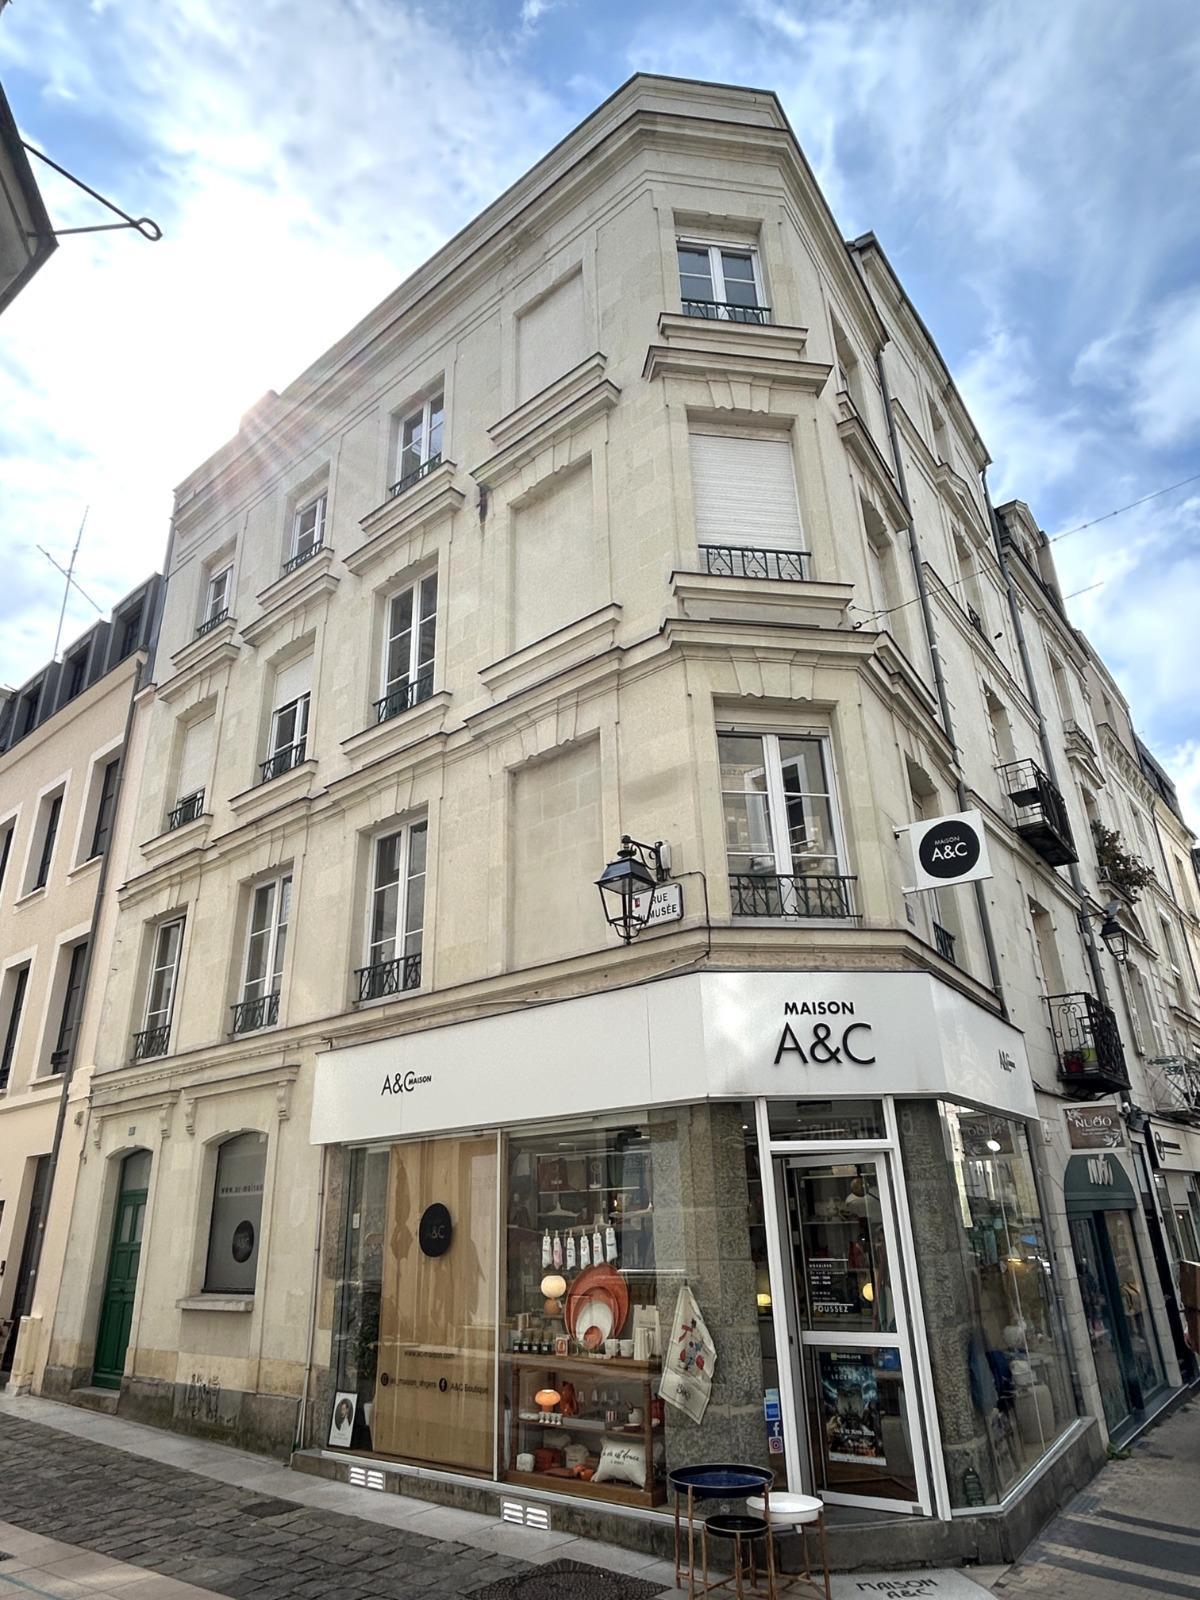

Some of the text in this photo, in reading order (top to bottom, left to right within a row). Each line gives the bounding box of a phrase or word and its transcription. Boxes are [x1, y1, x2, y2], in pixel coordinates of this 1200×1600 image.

[934, 835, 960, 846] MAISON
[931, 841, 968, 862] A&C
[651, 892, 668, 904] RUE
[648, 903, 677, 919] MUSÉE
[784, 1001, 855, 1015] MAISON
[773, 1021, 876, 1065] A&C
[380, 1070, 432, 1096] A&C MAISON
[813, 1305, 849, 1313] POUSSEZ
[855, 1578, 939, 1591] MAISON
[886, 1588, 934, 1599] A&C
